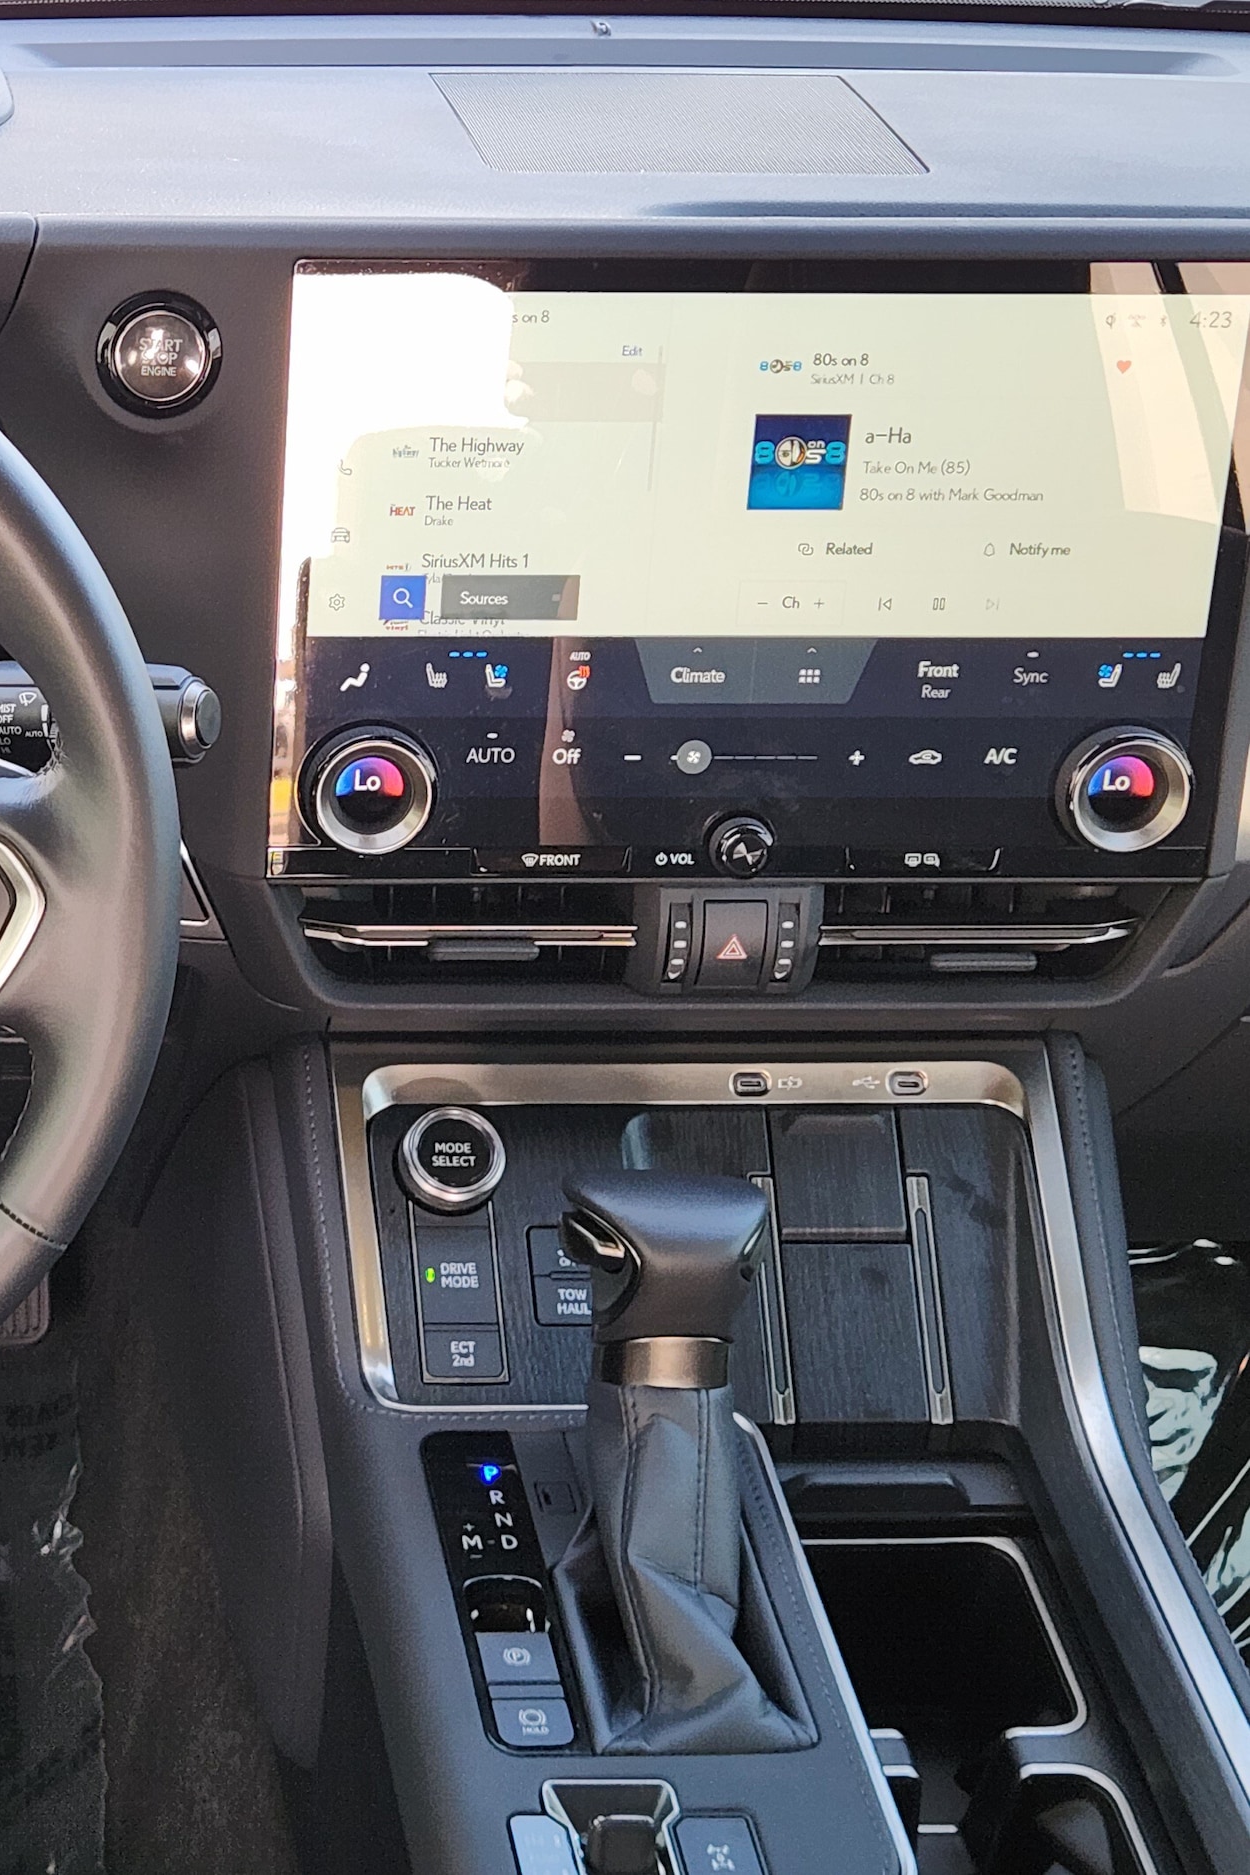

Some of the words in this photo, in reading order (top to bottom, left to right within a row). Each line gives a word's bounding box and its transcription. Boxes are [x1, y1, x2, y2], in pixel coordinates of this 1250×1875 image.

[521, 313, 538, 324] on
[541, 310, 550, 324] 8
[1189, 311, 1233, 328] 4:23
[622, 345, 643, 357] Edit
[813, 353, 837, 366] 80s
[841, 358, 857, 366] on
[860, 353, 869, 366] 8
[141, 366, 177, 376] ENGINE
[869, 373, 884, 385] Ch
[887, 373, 895, 385] 8
[864, 427, 912, 444] a-Ha
[430, 437, 457, 453] The
[461, 437, 525, 457] Highway
[428, 457, 461, 469] Tucker
[863, 461, 892, 474] Take
[895, 461, 914, 474] On
[917, 461, 937, 474] Me
[940, 459, 971, 476] (85)
[859, 488, 884, 501] 80s
[887, 491, 903, 501] on
[906, 488, 915, 501] 8
[919, 488, 945, 501] with
[948, 488, 979, 501] Mark
[983, 488, 1044, 501] Goodman
[425, 495, 453, 511] The
[457, 496, 492, 511] Heat
[424, 515, 454, 527] Drake
[825, 542, 873, 556] Related
[1009, 542, 1048, 558] Notify
[1050, 546, 1071, 556] me
[421, 553, 485, 569] SiriusXM
[489, 553, 519, 569] Hits
[522, 553, 529, 568] 1
[460, 591, 509, 606] Sources
[781, 596, 800, 609] Ch
[569, 651, 591, 661] AUTO
[670, 667, 726, 683] Climate
[917, 660, 960, 678] Front
[1013, 667, 1048, 686] Sync
[921, 685, 950, 698] Rear
[24, 730, 43, 738] AUTO
[466, 748, 515, 763] AUTO
[552, 748, 581, 764] Off
[984, 748, 1018, 765] A/C
[354, 769, 381, 792] Lo
[1102, 769, 1131, 792] Lo
[539, 854, 581, 866] FRONT
[670, 854, 694, 865] VOL
[434, 1141, 472, 1154] MODE
[431, 1155, 476, 1168] SELECT
[440, 1262, 477, 1276] DRIVE
[441, 1275, 479, 1289] MODE
[557, 1288, 588, 1301] TOW
[556, 1302, 593, 1315] HAUL
[450, 1341, 476, 1354] ECT
[452, 1354, 474, 1367] 2nd
[483, 1464, 499, 1482] P
[489, 1489, 505, 1505] R
[494, 1511, 513, 1527] N
[462, 1534, 483, 1550] M
[501, 1534, 518, 1550] D
